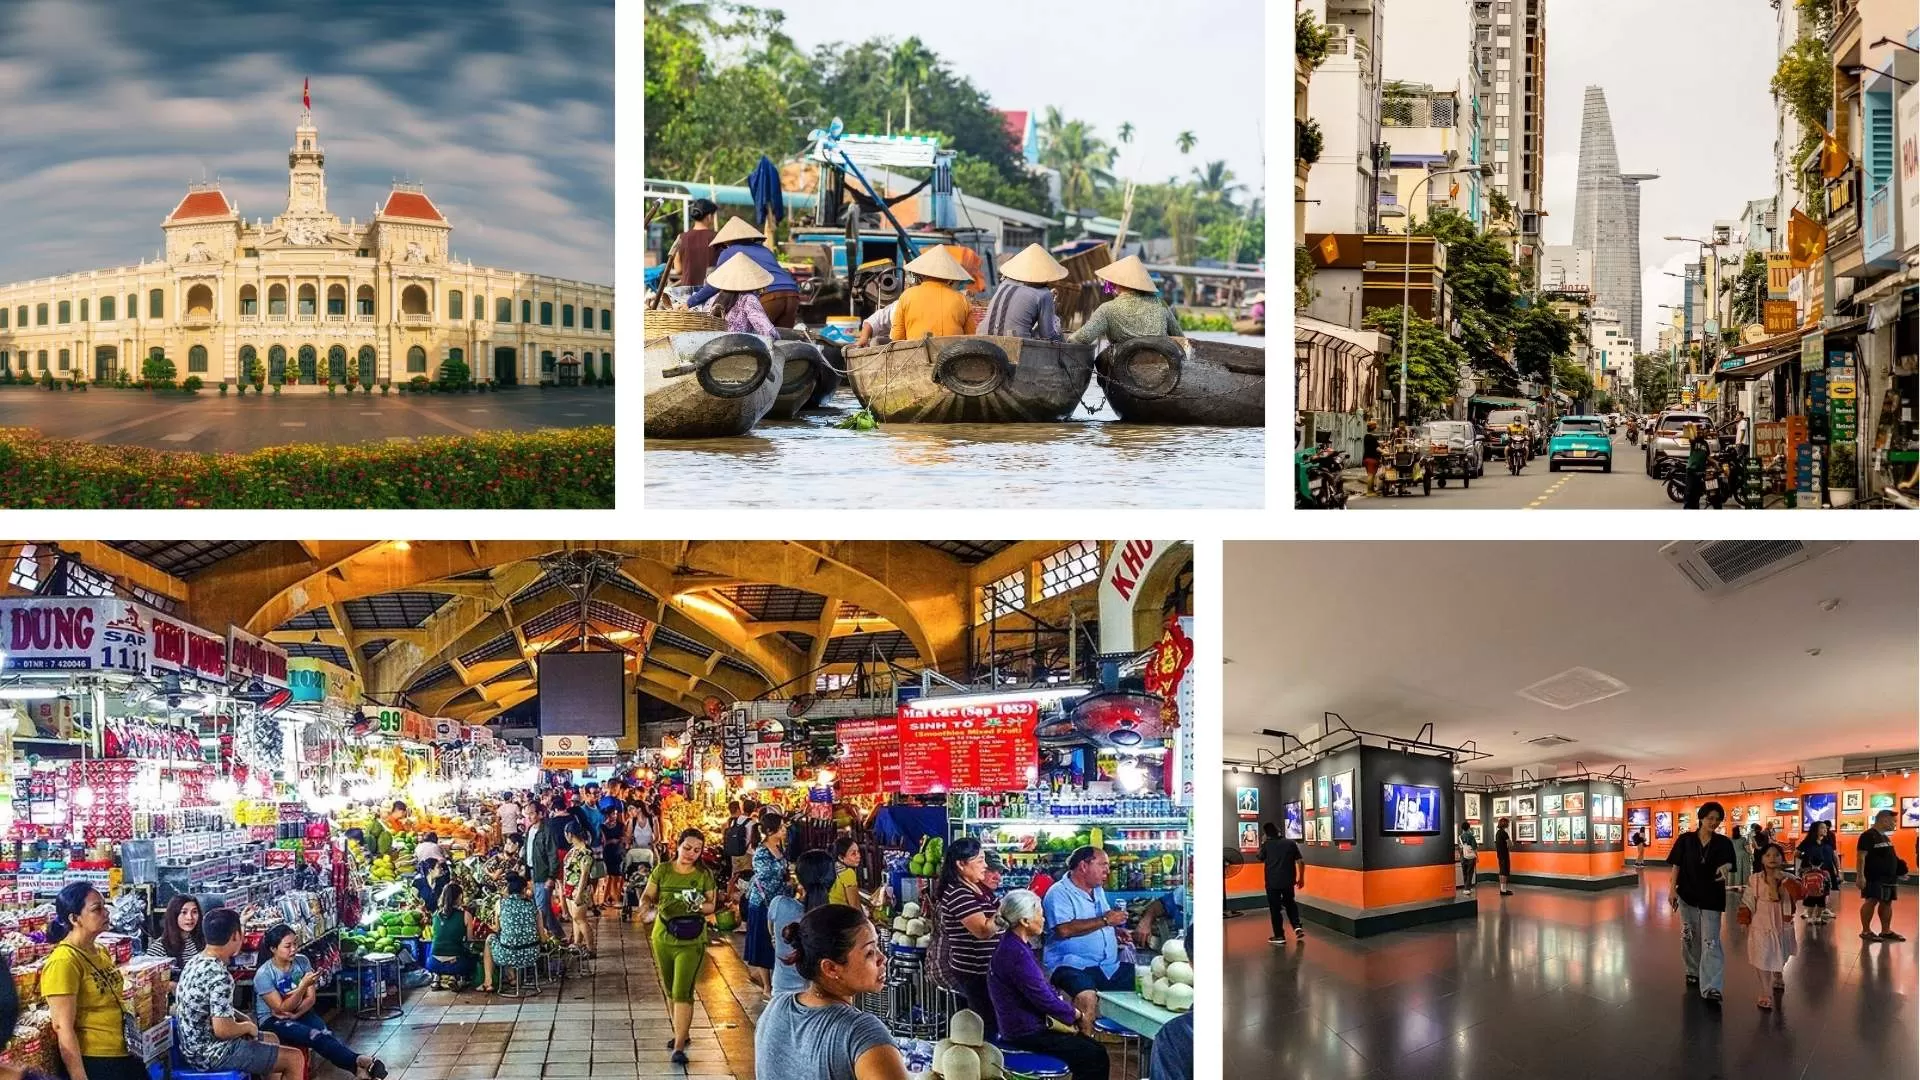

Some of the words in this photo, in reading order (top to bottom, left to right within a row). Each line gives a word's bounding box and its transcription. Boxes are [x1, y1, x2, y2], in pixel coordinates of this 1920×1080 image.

[10, 606, 95, 650] DUNG
[101, 645, 147, 673] 1111
[909, 722, 947, 731] SINH
